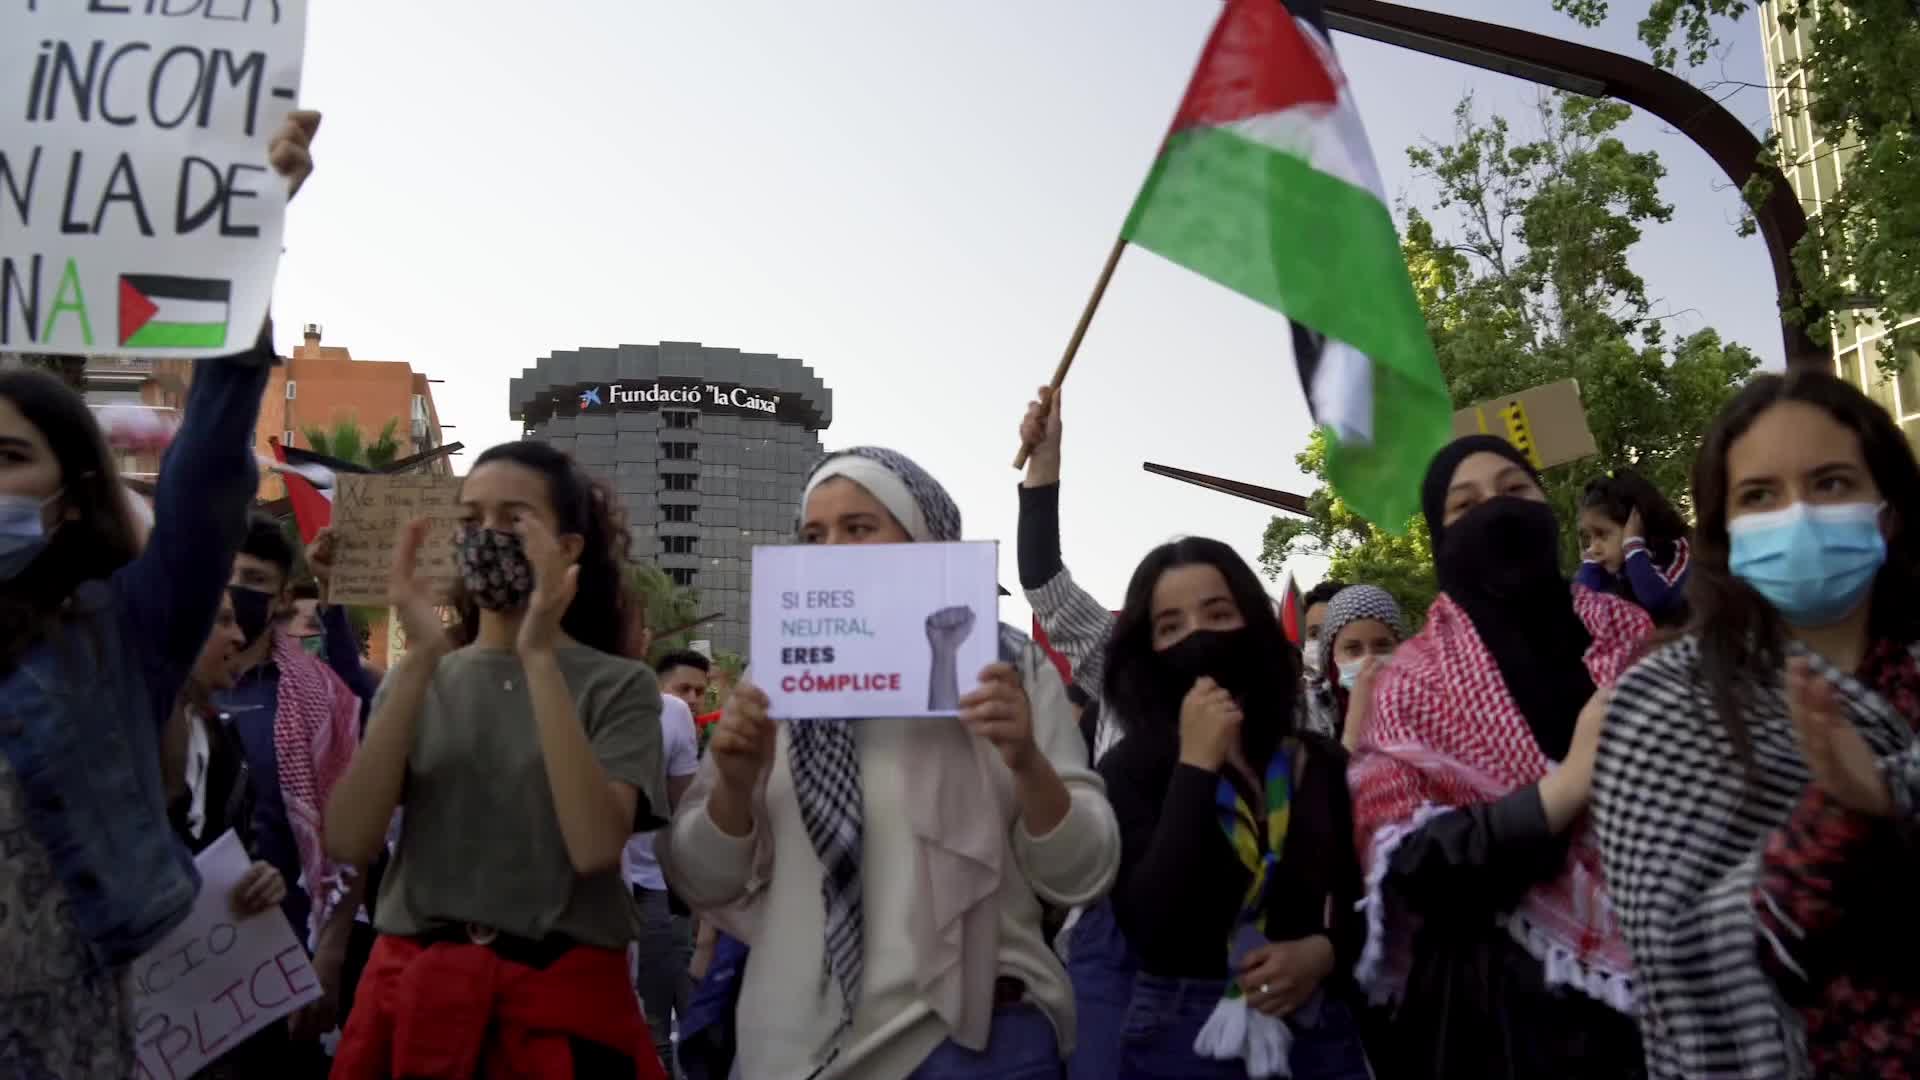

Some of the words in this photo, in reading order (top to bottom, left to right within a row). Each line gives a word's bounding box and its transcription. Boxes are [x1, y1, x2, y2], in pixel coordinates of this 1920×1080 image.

[60, 150, 155, 237] LA
[175, 156, 268, 238] DE
[609, 384, 701, 404] Fundació
[781, 591, 799, 610] SI
[806, 590, 855, 609] ERES
[781, 618, 875, 638] NEUTRAL,
[781, 647, 835, 665] ERES
[781, 671, 902, 693] CÓMPLICE
